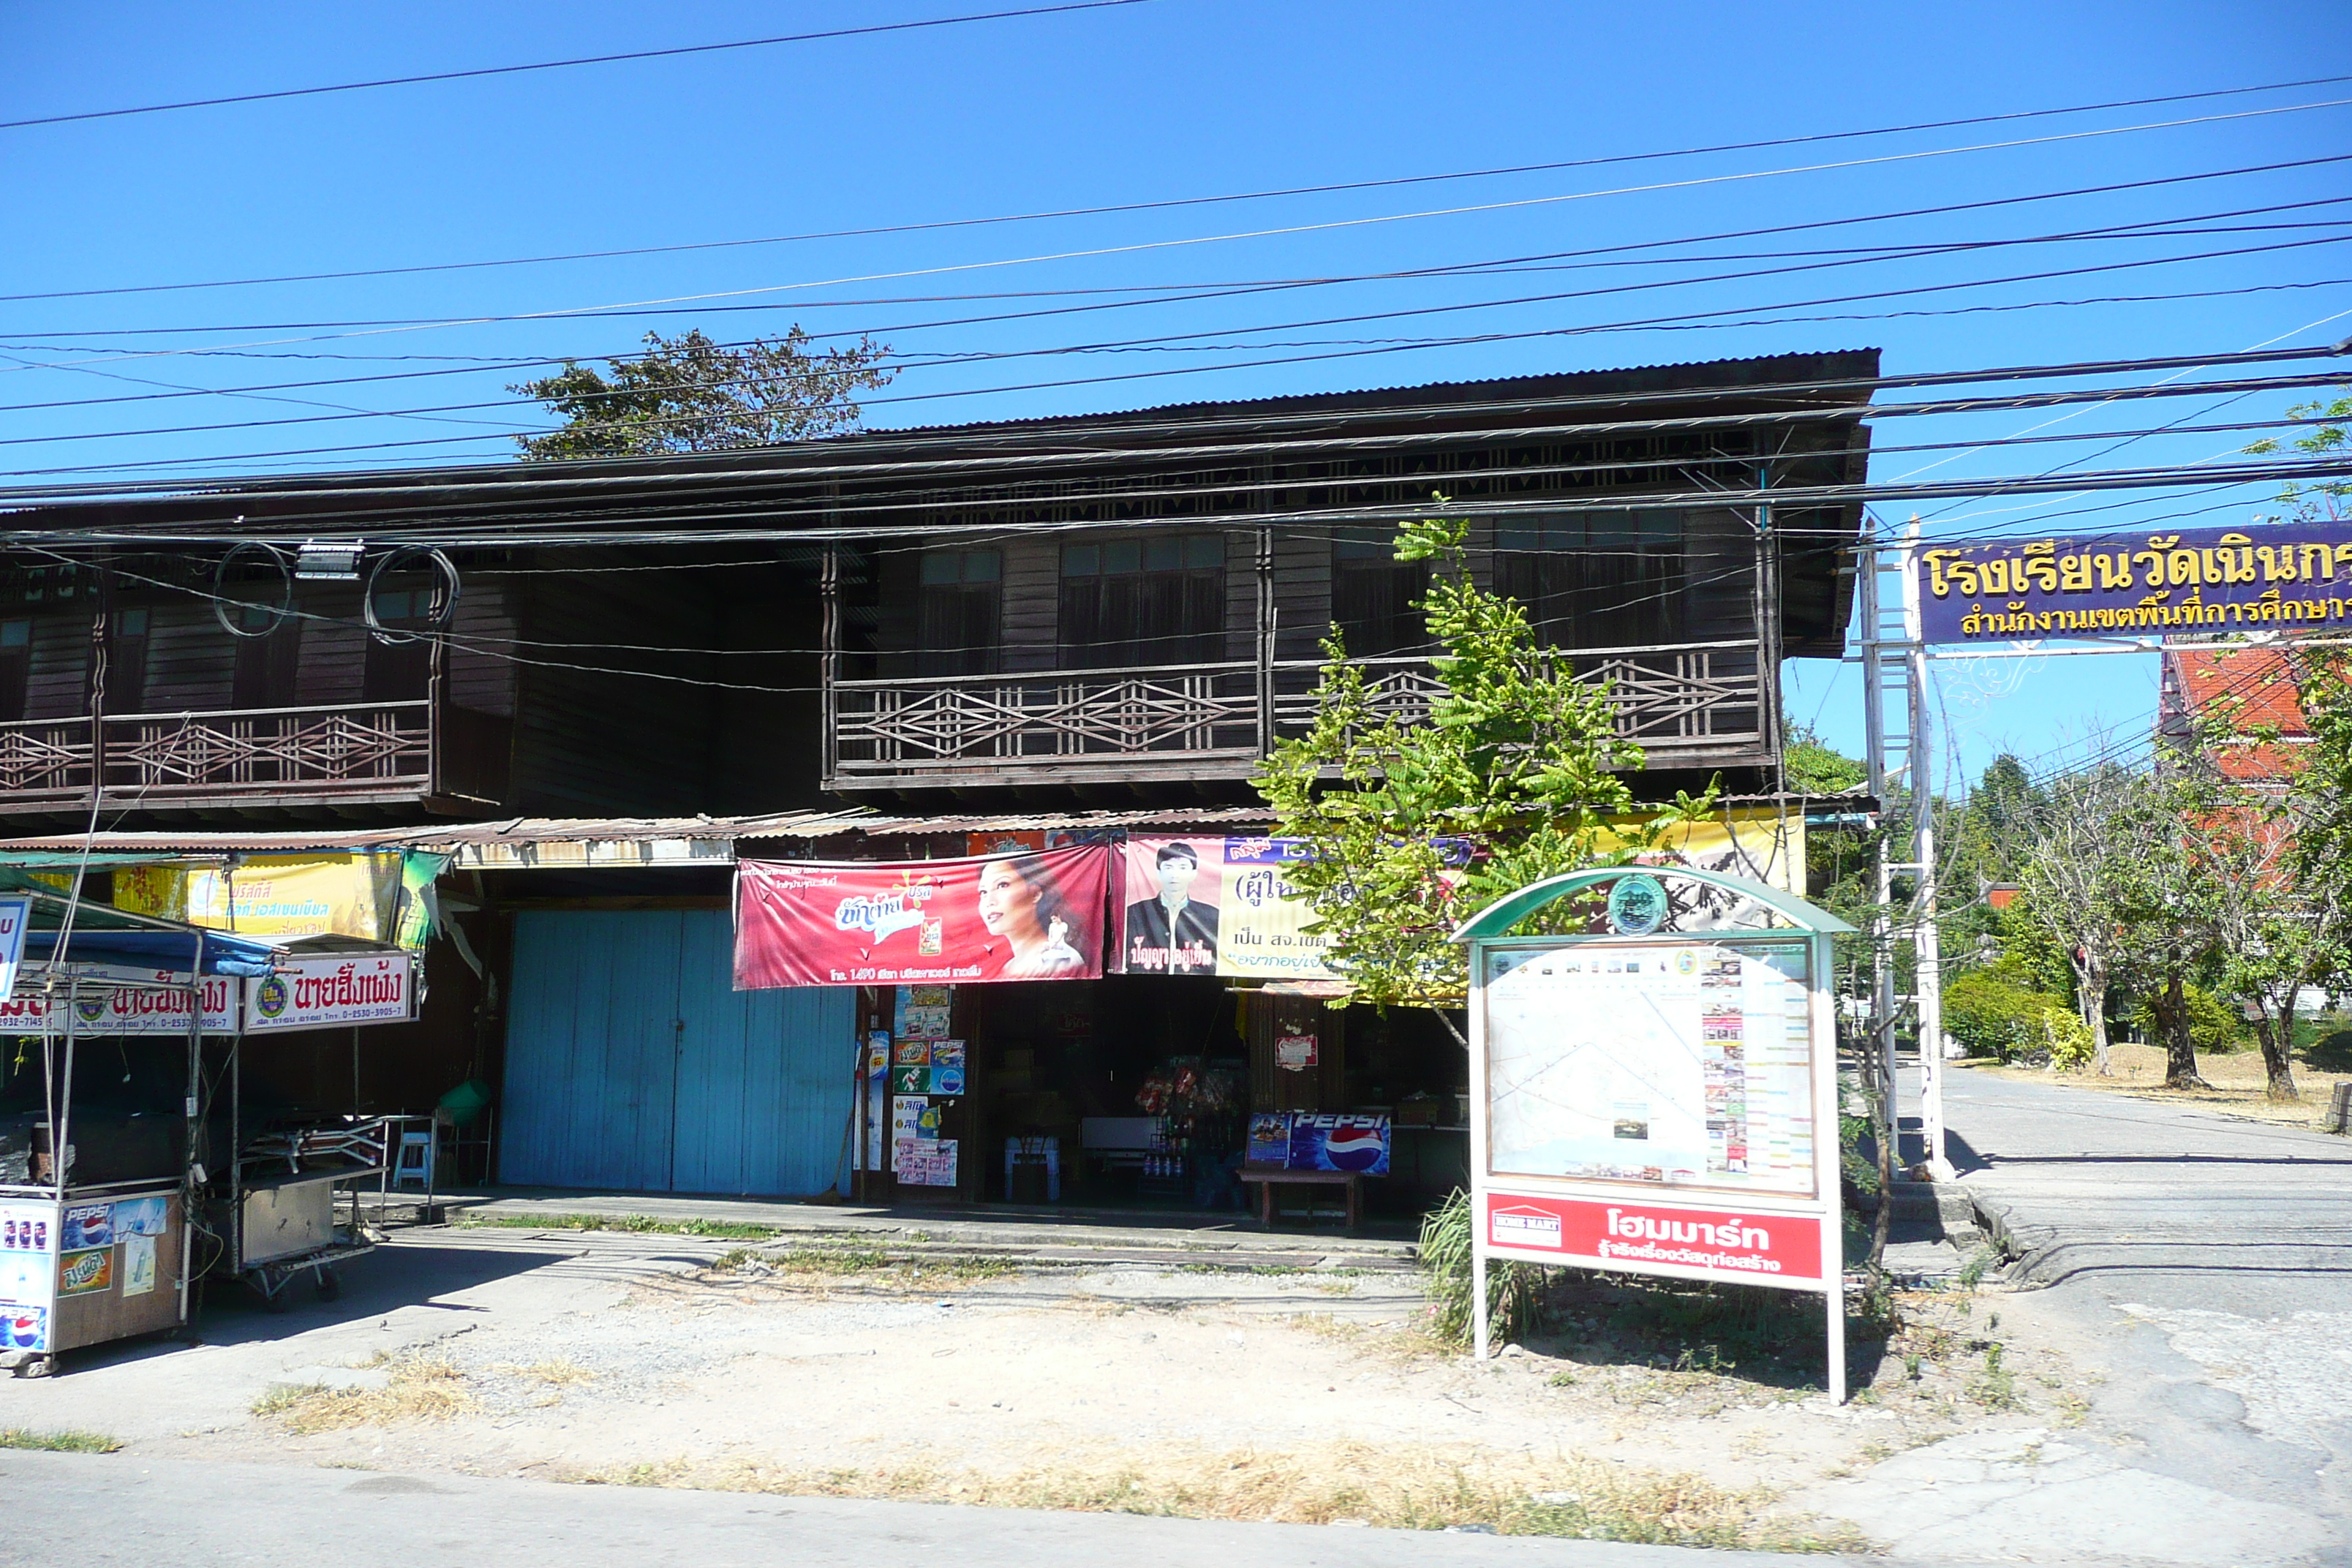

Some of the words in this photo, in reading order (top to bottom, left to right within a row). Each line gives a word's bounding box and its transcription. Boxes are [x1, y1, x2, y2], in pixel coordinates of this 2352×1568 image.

[1235, 927, 1262, 946] เป็น
[342, 1006, 402, 1019] 0-2530-3905-7
[162, 1018, 227, 1028] 0-2530-905-7
[933, 1041, 963, 1049] PEPSI
[1294, 1114, 1384, 1129] PEPSI
[67, 1205, 110, 1221] PEPSI
[1495, 1215, 1526, 1228] HOME
[1526, 1218, 1558, 1232] MART
[1607, 1208, 1770, 1251] โฮมมาร์ท
